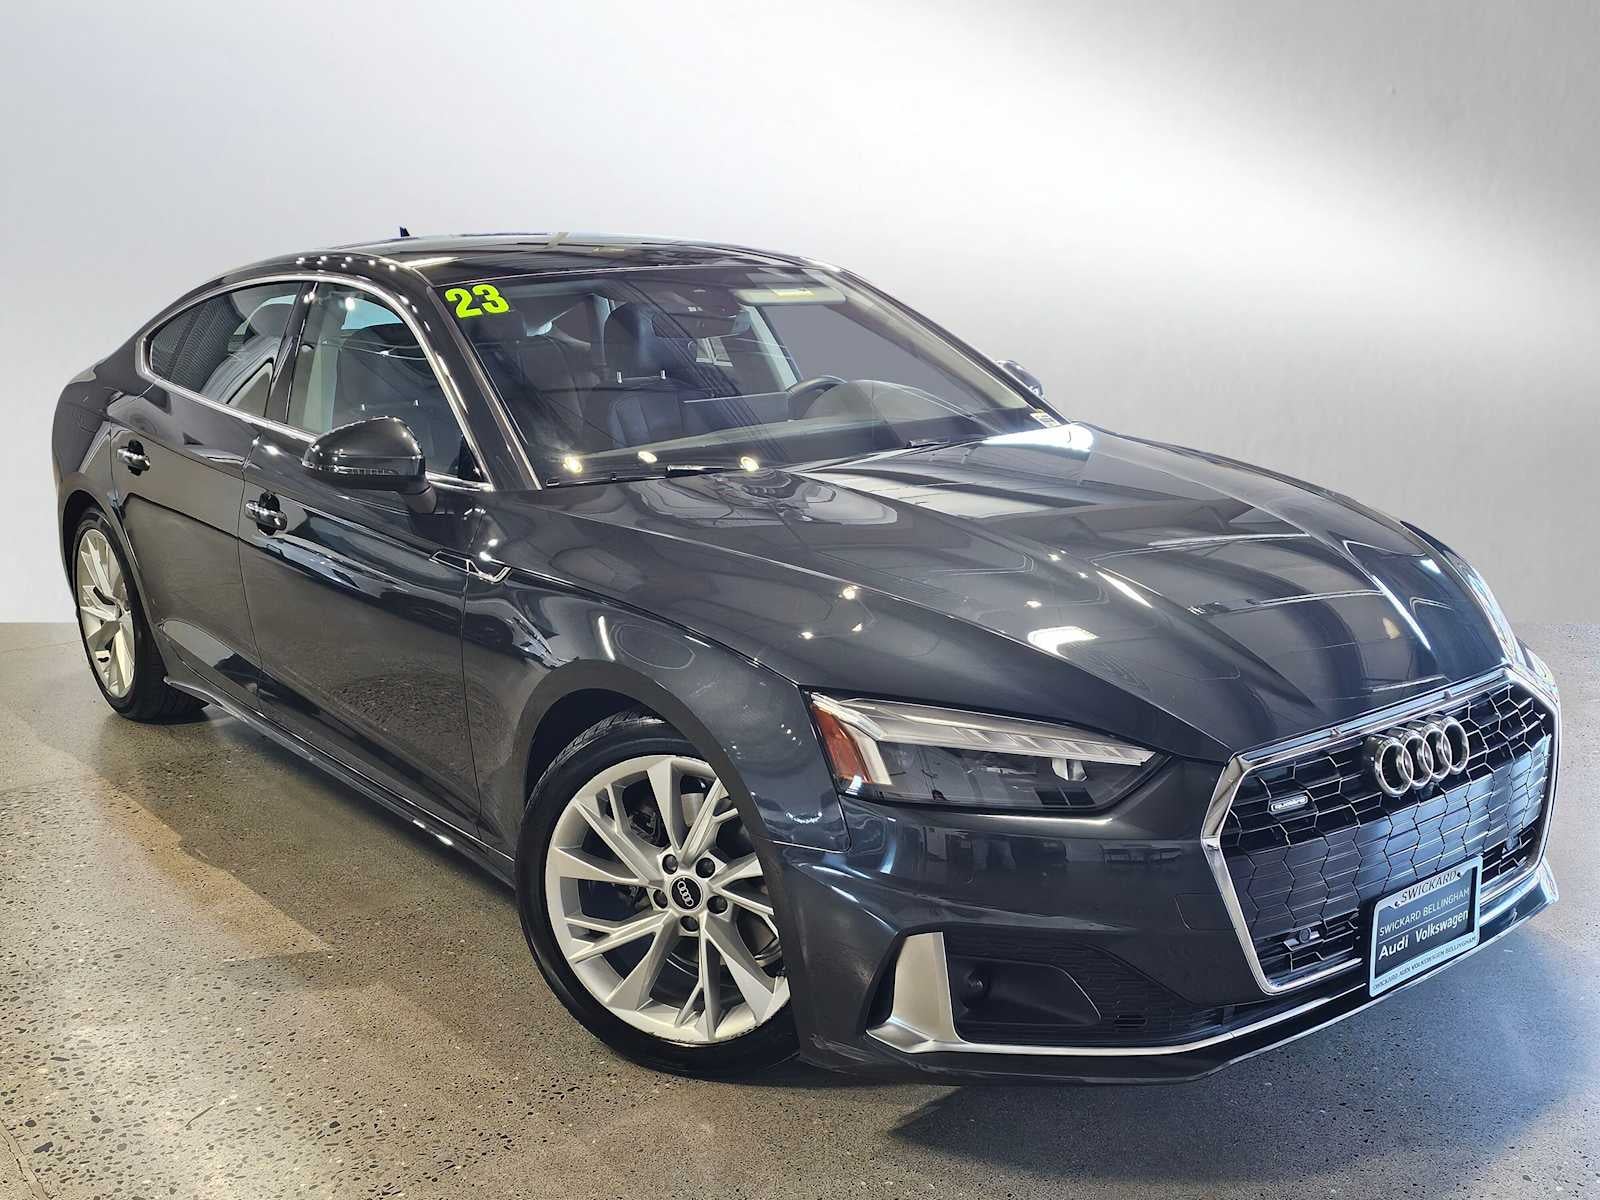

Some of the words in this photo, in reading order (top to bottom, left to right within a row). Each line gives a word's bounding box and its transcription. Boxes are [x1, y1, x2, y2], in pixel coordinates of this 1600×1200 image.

[445, 284, 509, 318] 23
[1401, 871, 1457, 903] SWICKARD
[1379, 911, 1421, 937] SWICKARD
[1423, 887, 1470, 917] BELLINGHAM
[1378, 934, 1409, 961] Audi
[1415, 910, 1469, 943] Volkswagen
